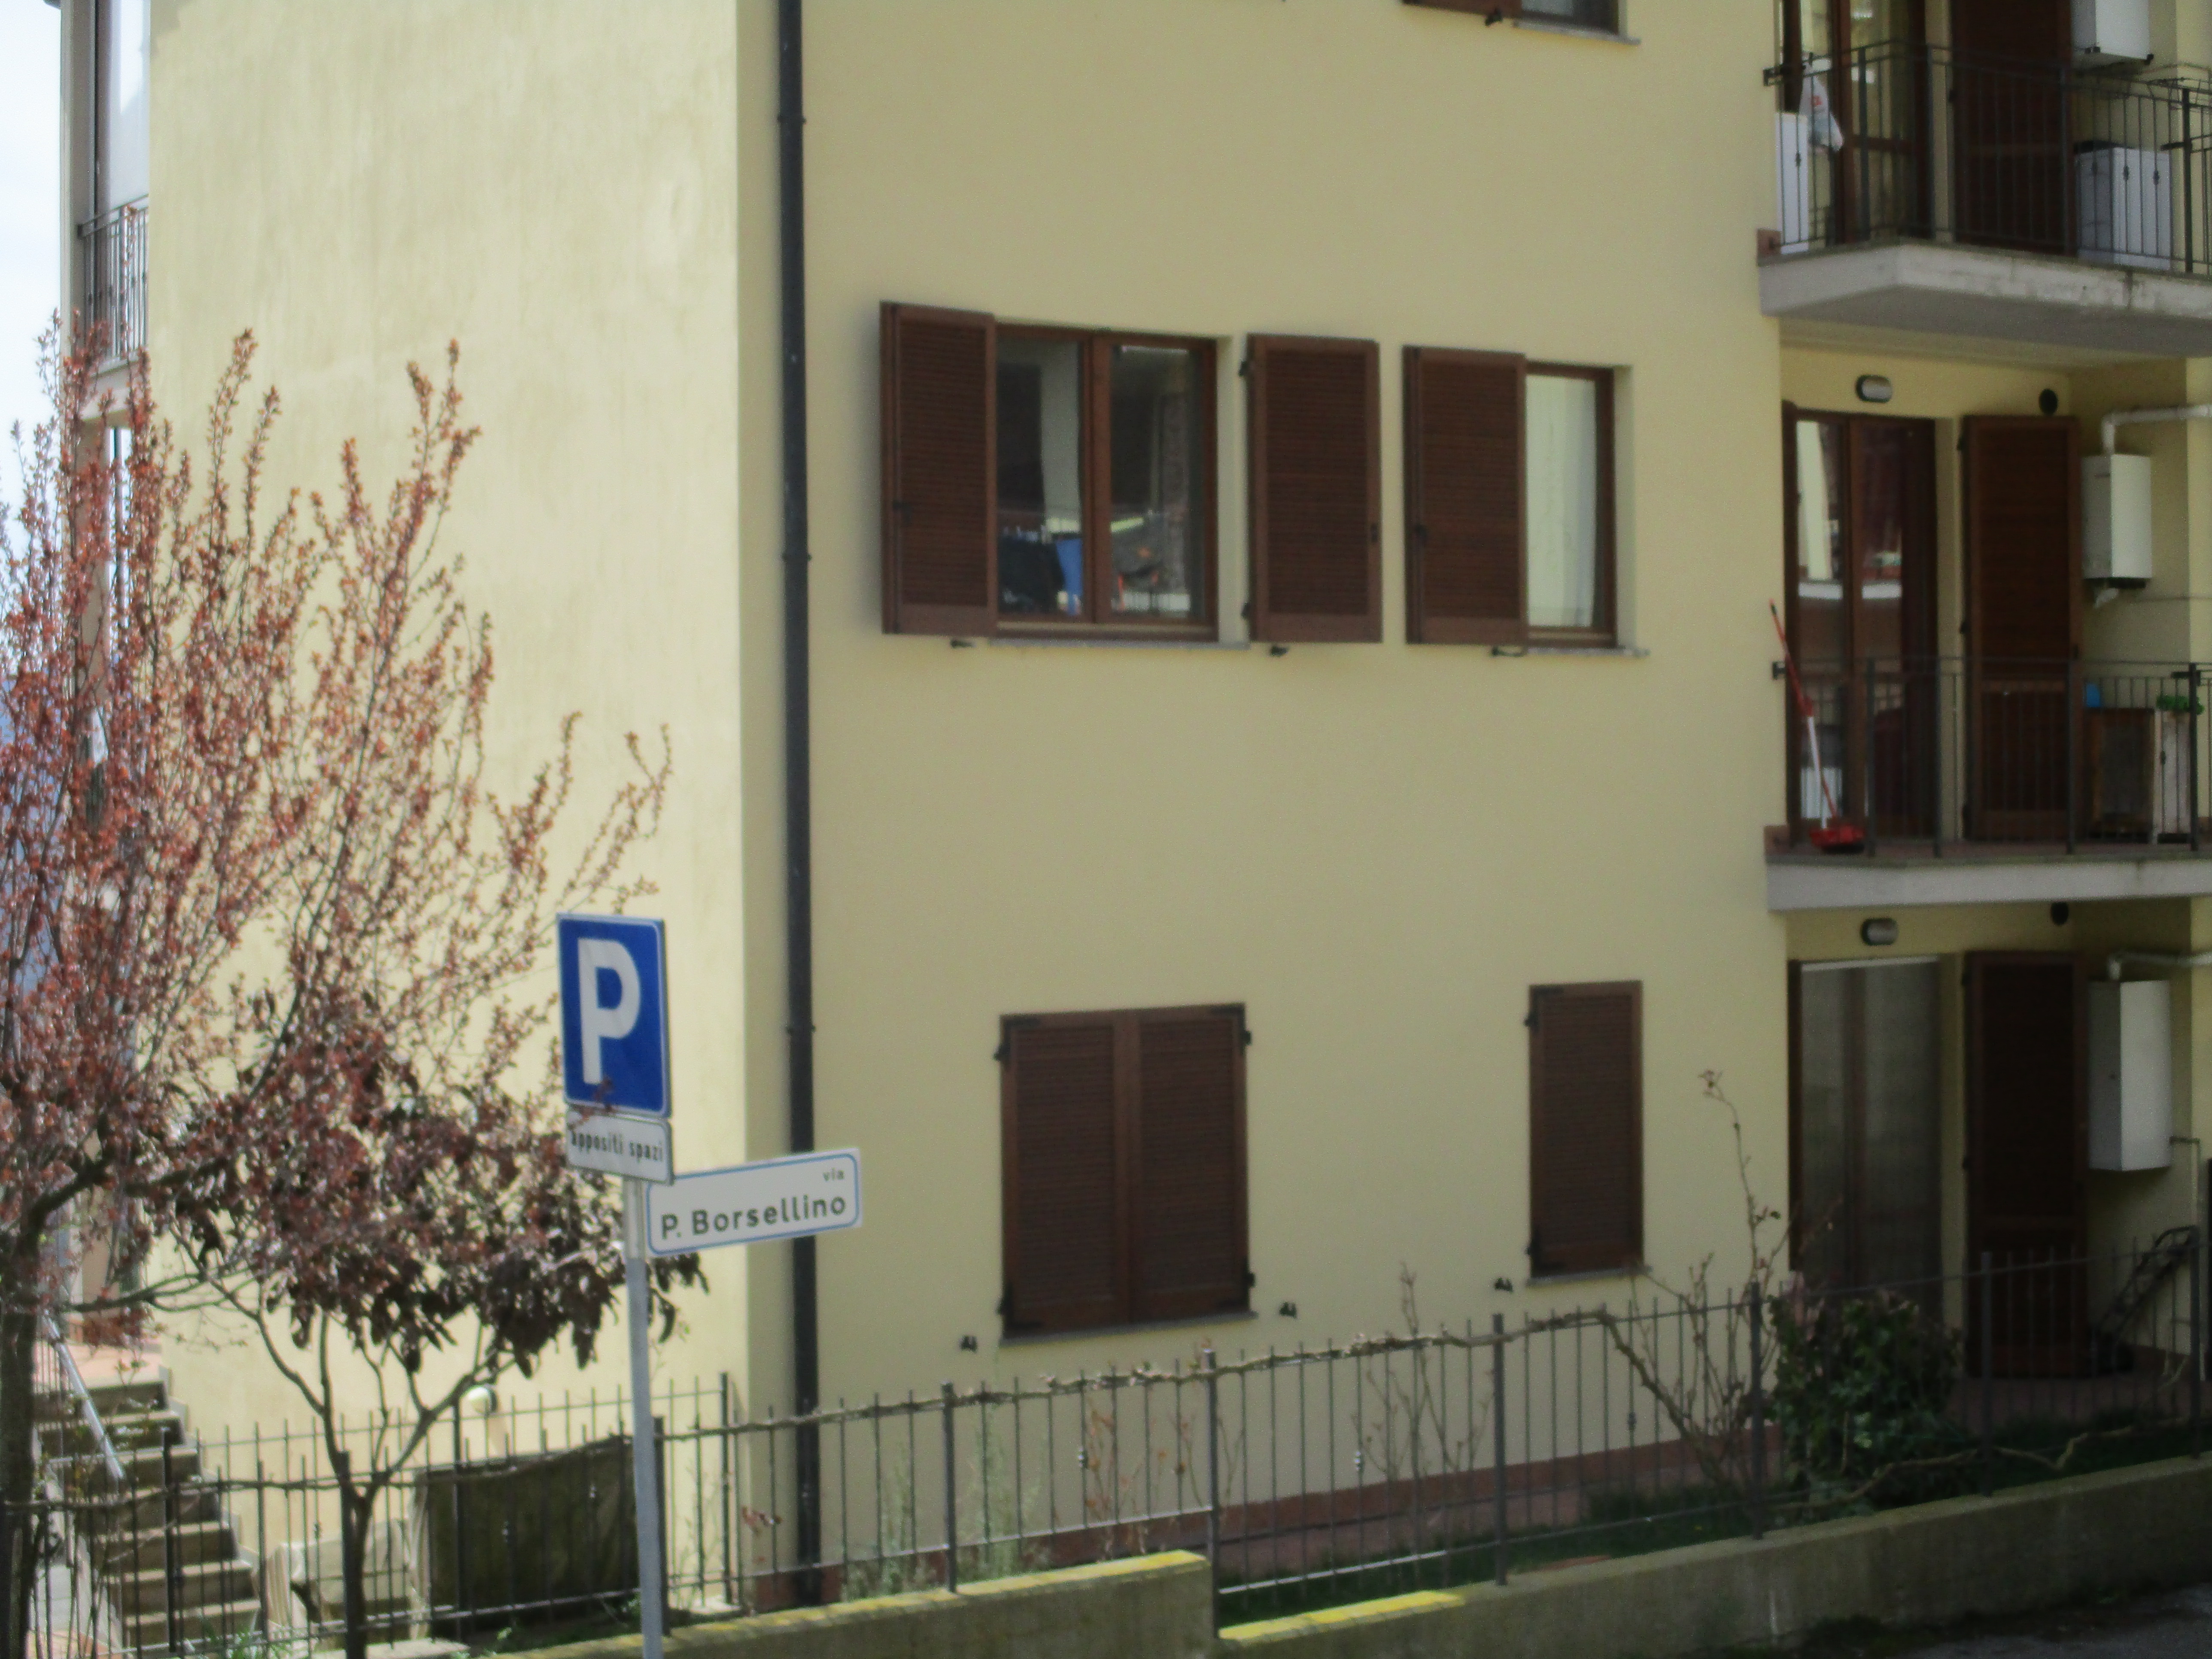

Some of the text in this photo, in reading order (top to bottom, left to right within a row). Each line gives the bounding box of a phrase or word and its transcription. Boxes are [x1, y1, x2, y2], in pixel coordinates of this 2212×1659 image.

[577, 937, 641, 1085] P
[629, 1140, 663, 1162] spazi
[823, 1168, 845, 1182] via
[661, 1194, 846, 1240] P. Borsellino
